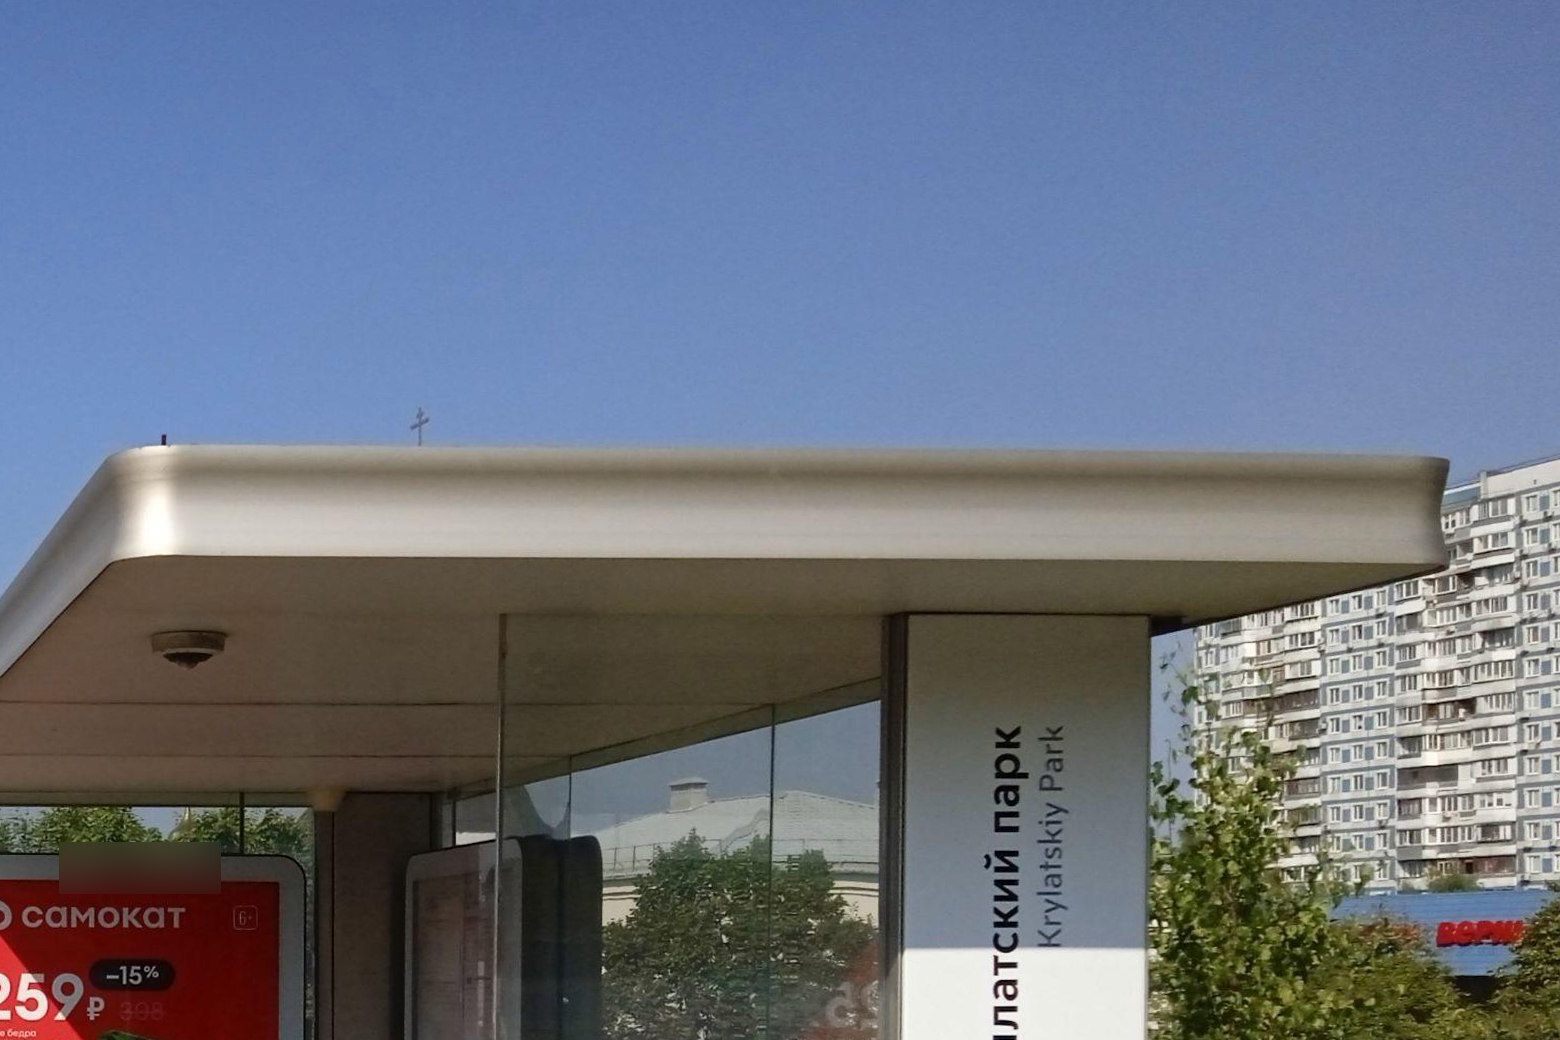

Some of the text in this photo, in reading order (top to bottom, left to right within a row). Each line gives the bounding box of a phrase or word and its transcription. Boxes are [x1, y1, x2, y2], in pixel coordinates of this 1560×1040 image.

[993, 726, 1029, 833] парк
[1036, 726, 1069, 947] Krylatskiy Park
[21, 906, 186, 929] самокат
[7, 1028, 37, 1038] бедра
